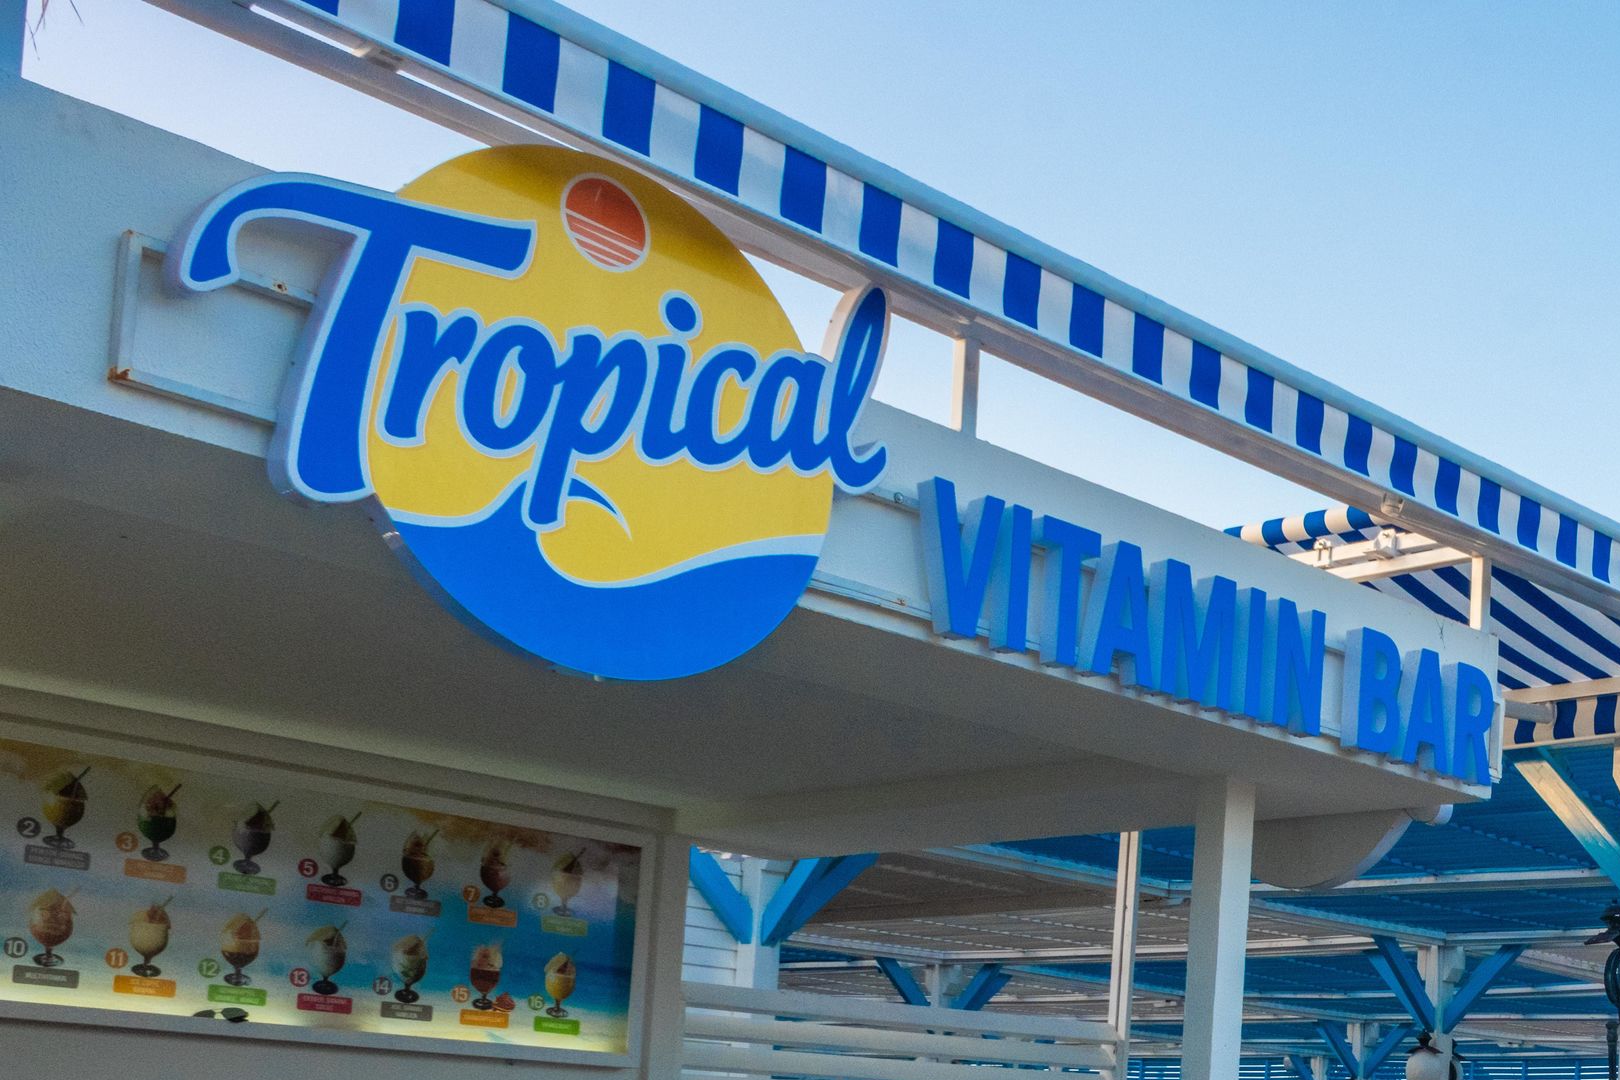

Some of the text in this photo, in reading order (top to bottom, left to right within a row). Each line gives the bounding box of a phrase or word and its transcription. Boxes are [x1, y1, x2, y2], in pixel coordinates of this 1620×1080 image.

[184, 174, 889, 529] Tropical
[919, 477, 1495, 786] VITAMIN BAR
[22, 820, 35, 836] 2
[6, 940, 25, 955] 10
[110, 952, 124, 966] 11
[202, 961, 219, 975] 12
[293, 971, 308, 984] 13
[375, 979, 389, 993] 14
[453, 987, 469, 1002] 15
[529, 994, 544, 1009] 16
